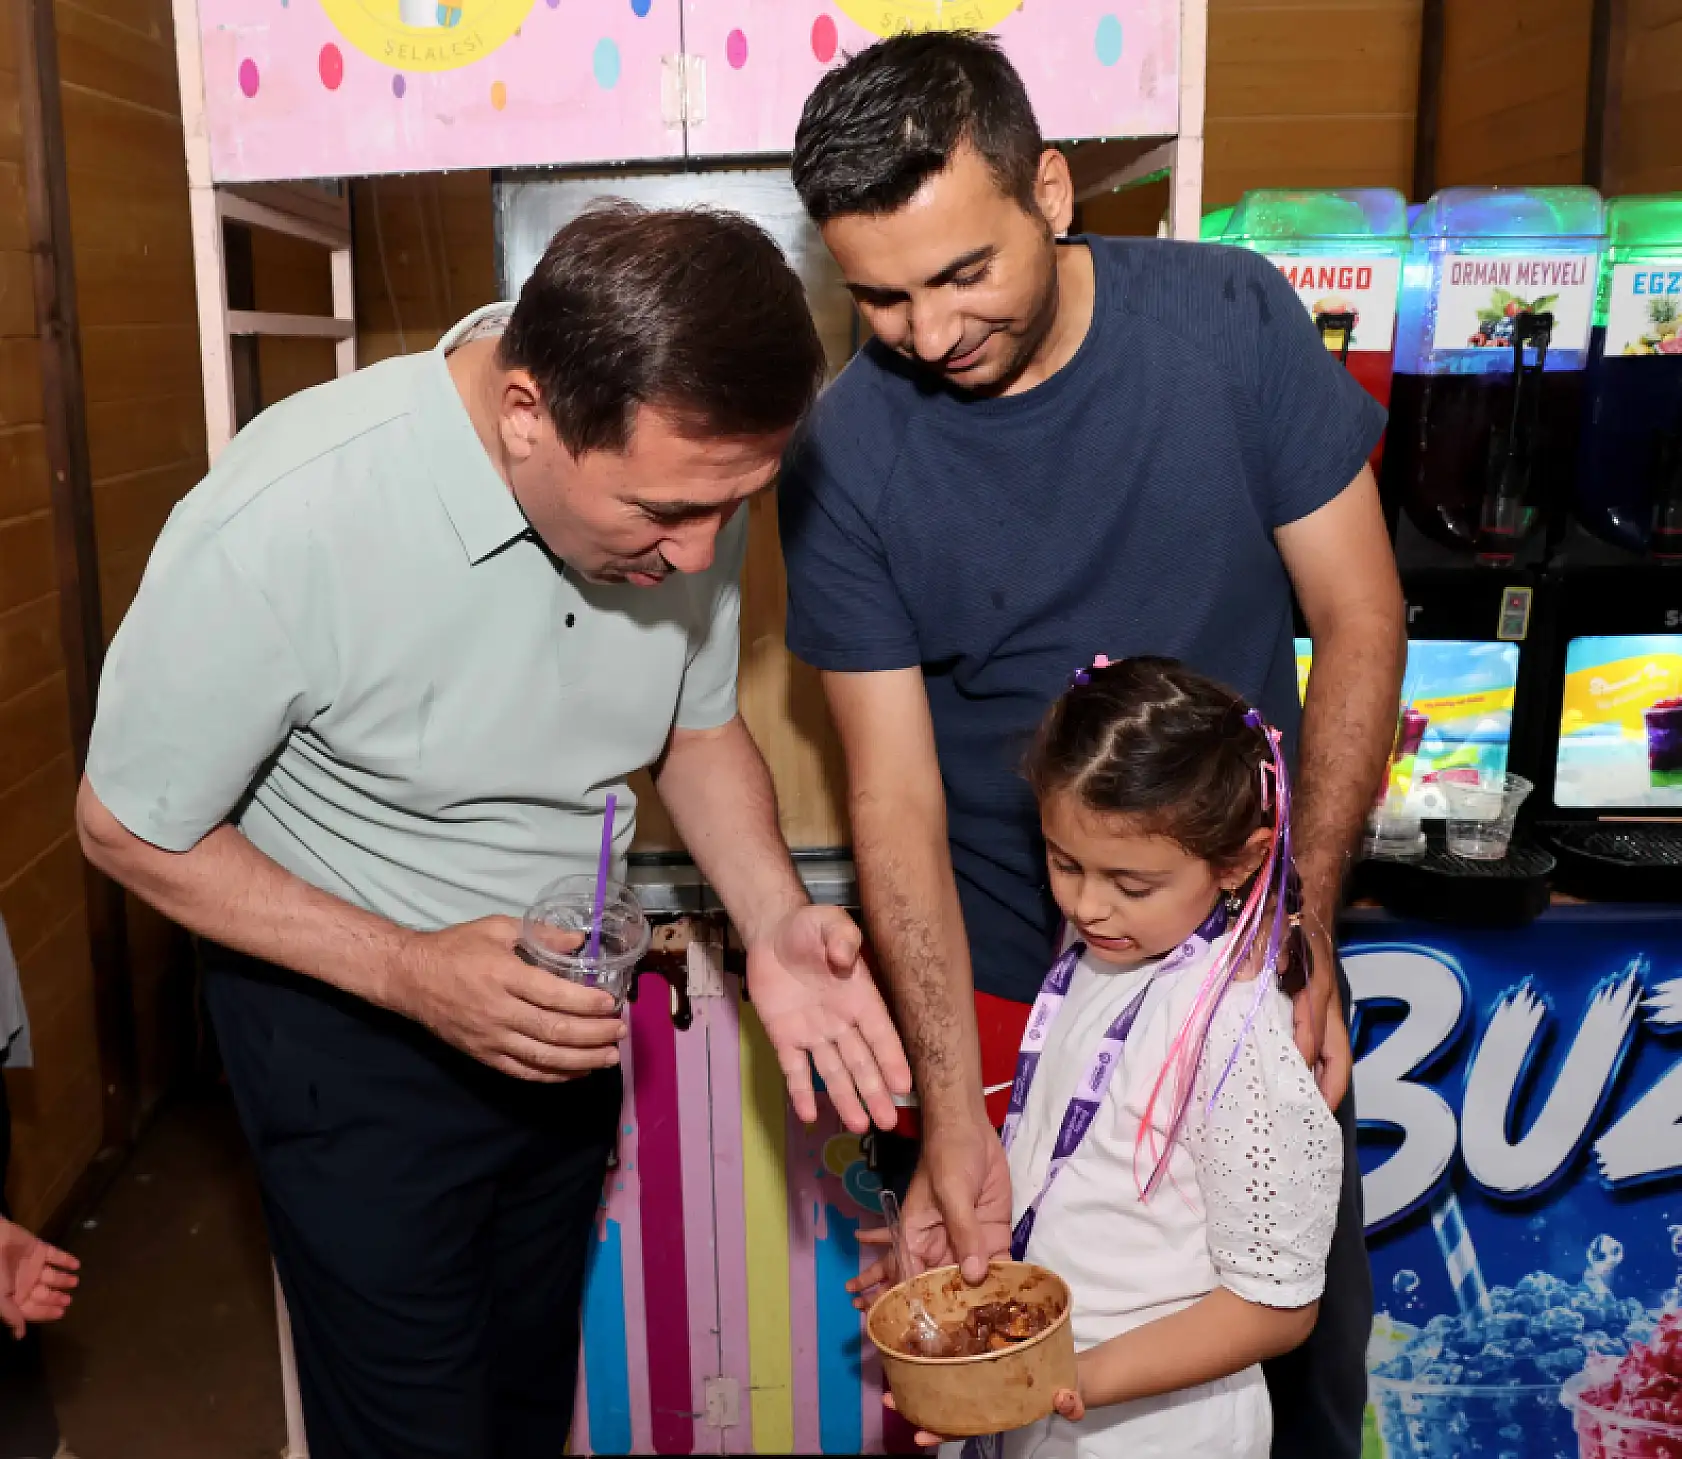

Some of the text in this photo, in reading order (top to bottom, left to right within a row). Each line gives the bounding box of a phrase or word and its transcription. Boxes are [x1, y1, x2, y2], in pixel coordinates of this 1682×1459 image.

[1278, 266, 1373, 290] MANGO
[1451, 257, 1588, 286] ORMAN MEYVELİ
